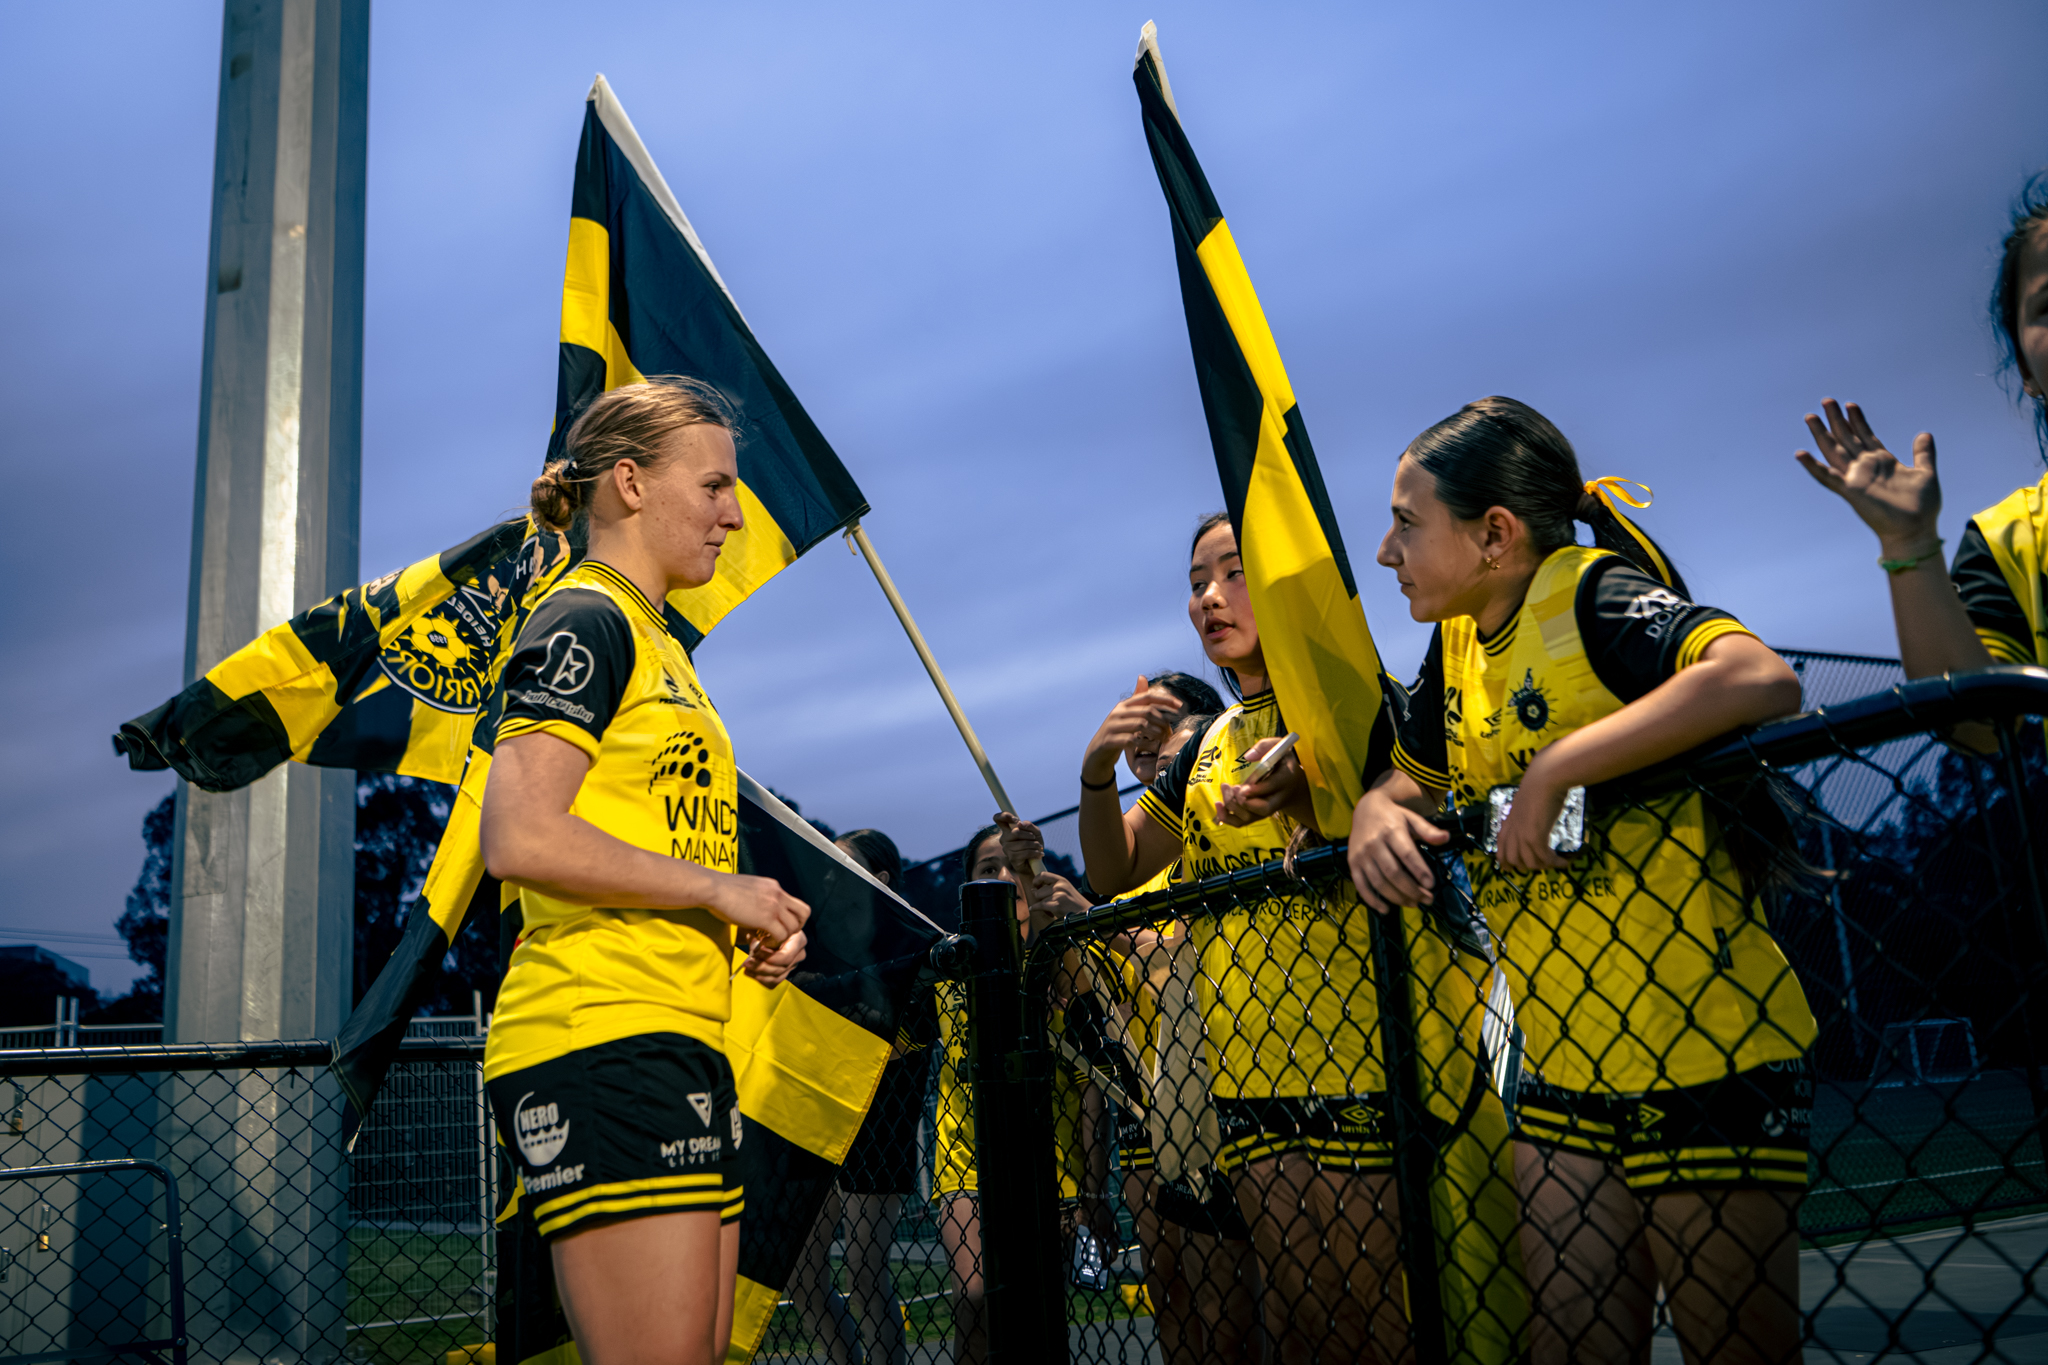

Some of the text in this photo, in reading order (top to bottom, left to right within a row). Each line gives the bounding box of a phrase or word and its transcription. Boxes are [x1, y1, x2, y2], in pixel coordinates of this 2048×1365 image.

[671, 837, 738, 875] MANA
[520, 1102, 560, 1133] HERO
[660, 1139, 685, 1158] MY
